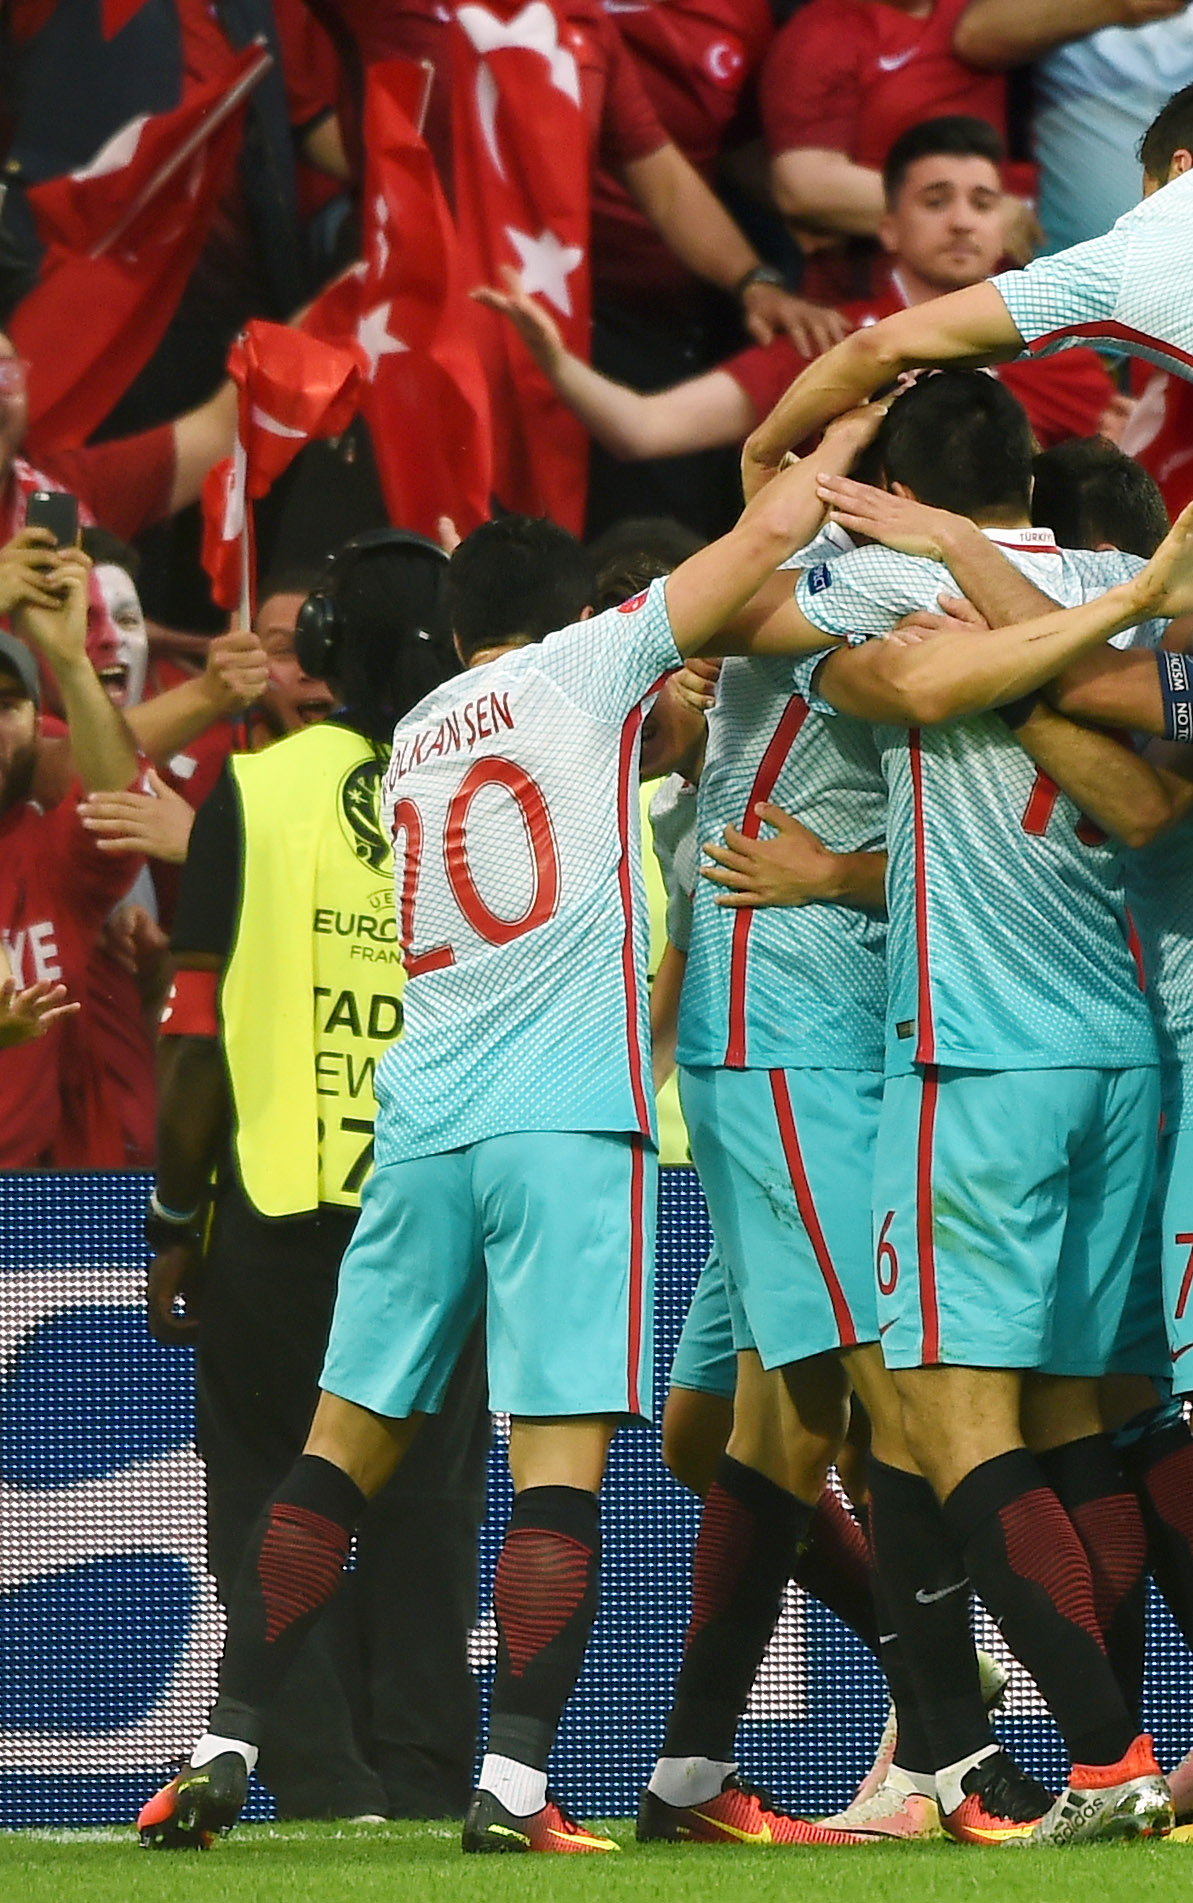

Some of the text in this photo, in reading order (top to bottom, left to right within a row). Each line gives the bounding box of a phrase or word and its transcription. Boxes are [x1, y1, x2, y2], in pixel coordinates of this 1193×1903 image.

[382, 691, 515, 805] OLKAN ŞEN
[1176, 702, 1189, 726] NO
[391, 754, 562, 979] 20
